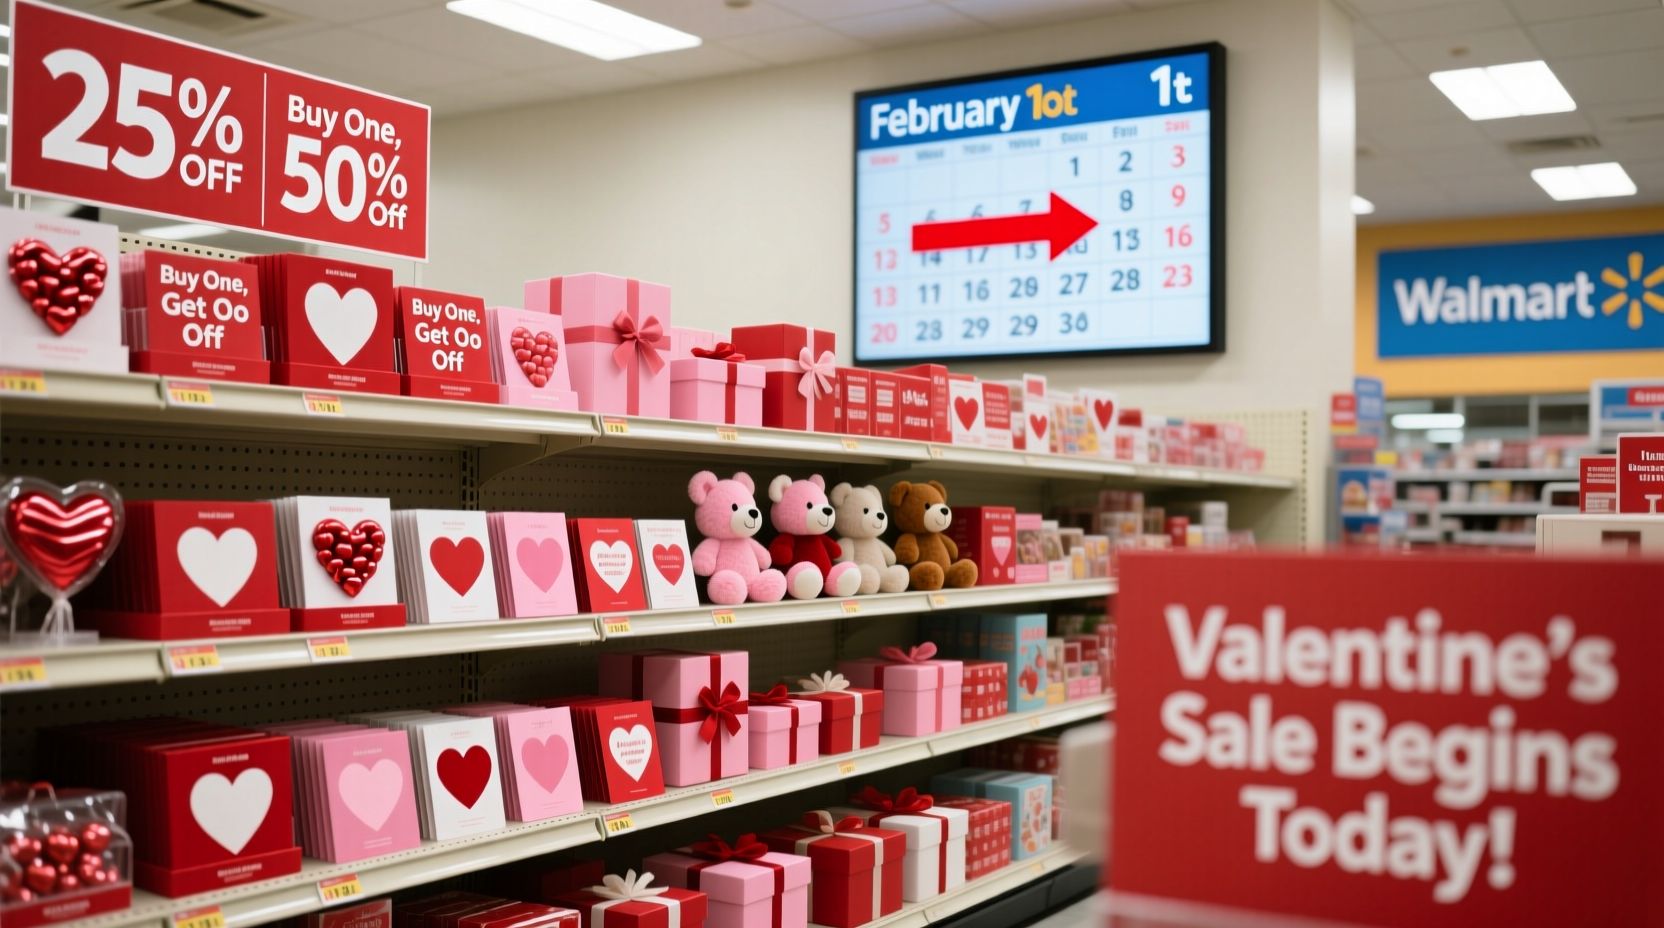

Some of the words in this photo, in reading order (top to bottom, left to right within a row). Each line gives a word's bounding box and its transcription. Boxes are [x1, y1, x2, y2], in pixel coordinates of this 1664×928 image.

[1150, 64, 1193, 107] 1t
[41, 48, 243, 180] 25%
[287, 94, 338, 138] Buy
[344, 108, 402, 149] One,
[870, 93, 1021, 139] February
[1025, 83, 1078, 120] 1ot
[179, 154, 243, 193] OFF
[280, 134, 408, 222] 50%
[1070, 156, 1079, 176] 1
[1119, 151, 1133, 172] 2
[1170, 145, 1186, 168] 3
[368, 200, 408, 230] Off
[878, 213, 891, 234] 5
[1120, 190, 1134, 211] 8
[1172, 185, 1186, 207] 9
[1164, 226, 1193, 248] 16
[160, 264, 199, 293] Buy
[203, 270, 248, 297] One,
[918, 283, 941, 304] 11
[964, 279, 990, 301] 16
[1059, 273, 1088, 295] 27
[1111, 269, 1140, 291] 28
[1163, 265, 1192, 288] 23
[1394, 271, 1595, 326] Walmart
[161, 292, 207, 319] Get
[213, 298, 249, 323] Oo
[412, 298, 442, 323] Buy
[445, 303, 481, 325] One,
[182, 323, 225, 349] Off
[415, 322, 449, 346] Get
[454, 327, 482, 349] Oo
[872, 323, 898, 344] 20
[962, 318, 989, 339] 29
[1009, 315, 1038, 337] 29
[432, 349, 464, 372] Off
[1158, 691, 1318, 775] Sale
[1332, 700, 1620, 810] Begins
[1238, 784, 1517, 904] Today!
